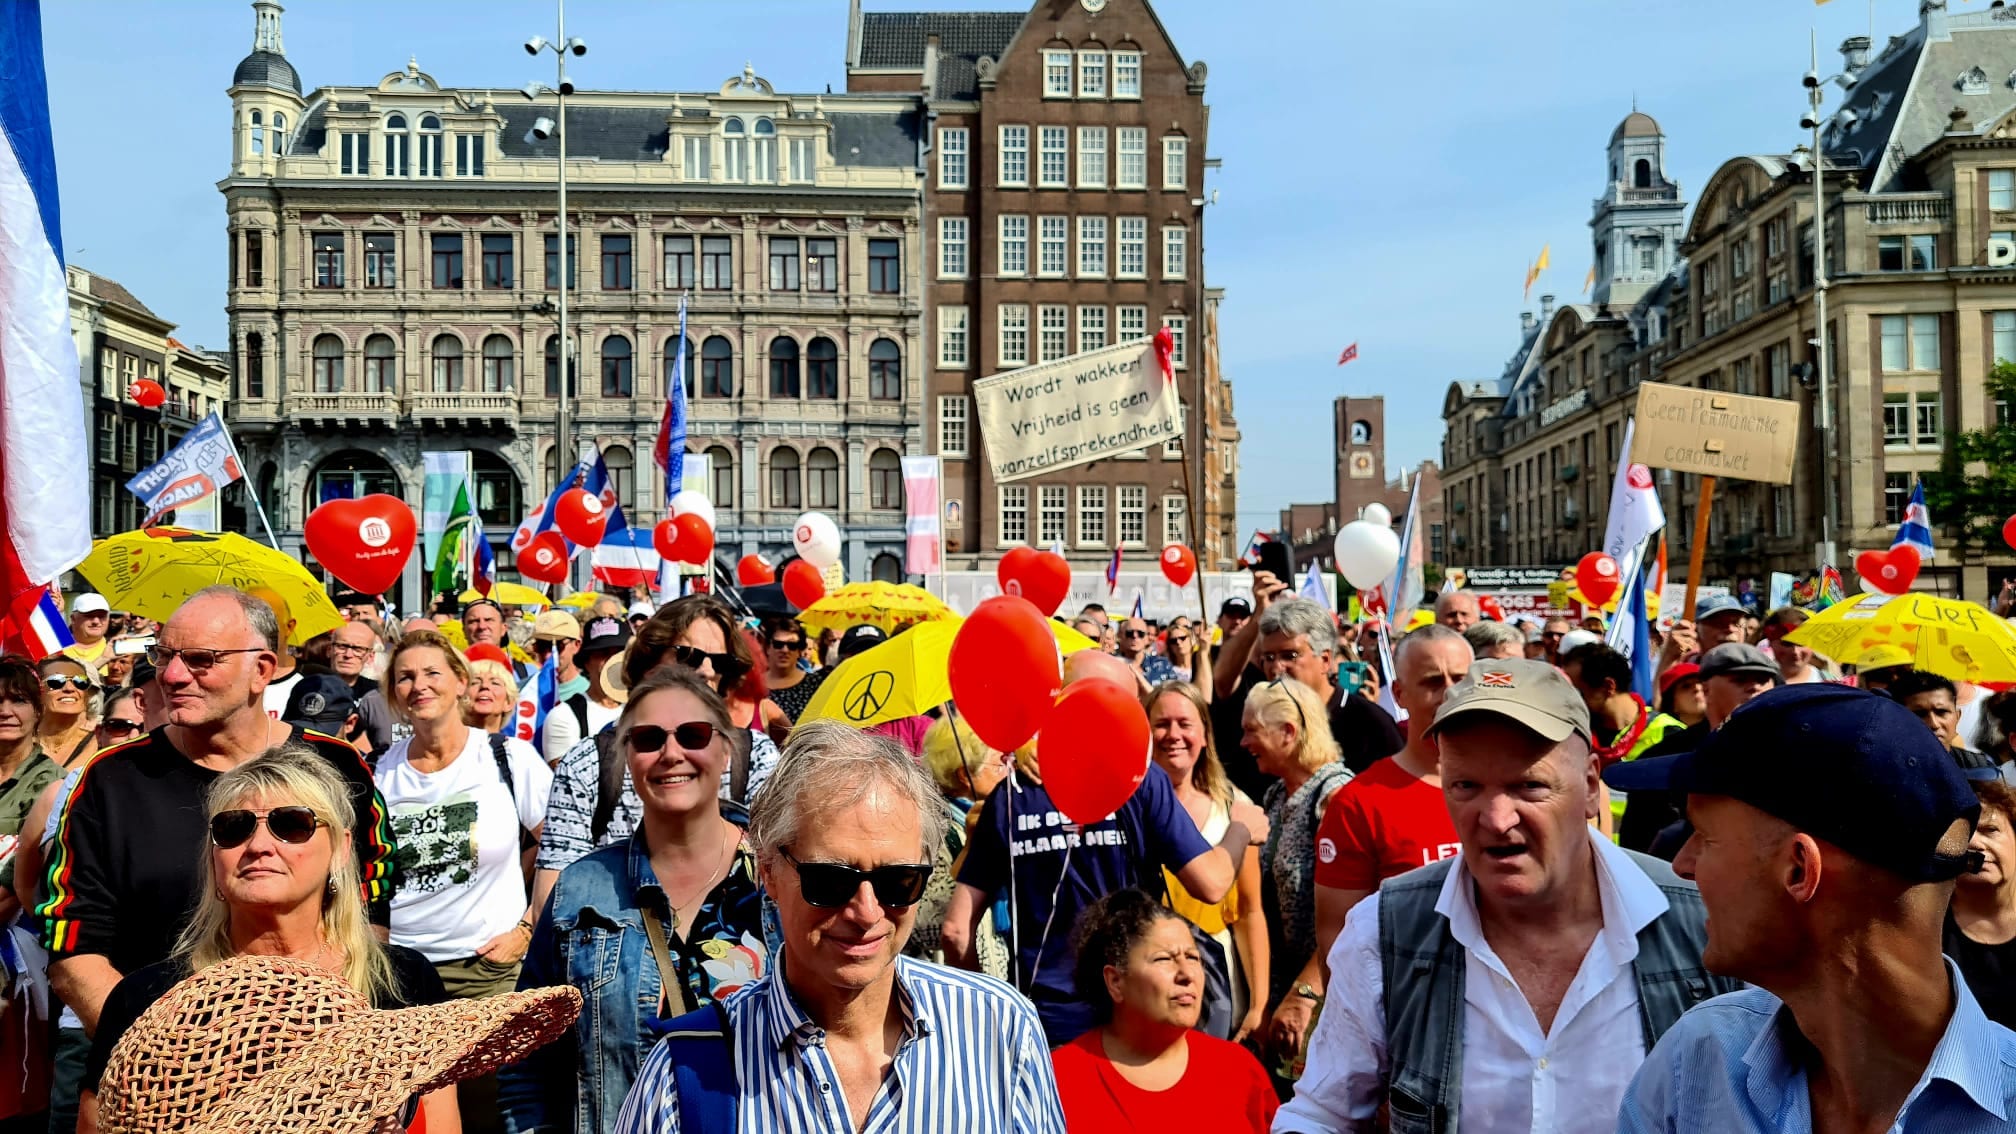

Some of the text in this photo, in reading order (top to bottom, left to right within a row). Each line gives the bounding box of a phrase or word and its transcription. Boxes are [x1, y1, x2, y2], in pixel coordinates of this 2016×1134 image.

[1005, 377, 1063, 404] Wordt
[1011, 390, 1149, 438] Vrijheid is geen
[999, 415, 1174, 475] vanzelfsprekendheid
[1018, 814, 1041, 831] IK
[1011, 833, 1081, 856] KLAAR
